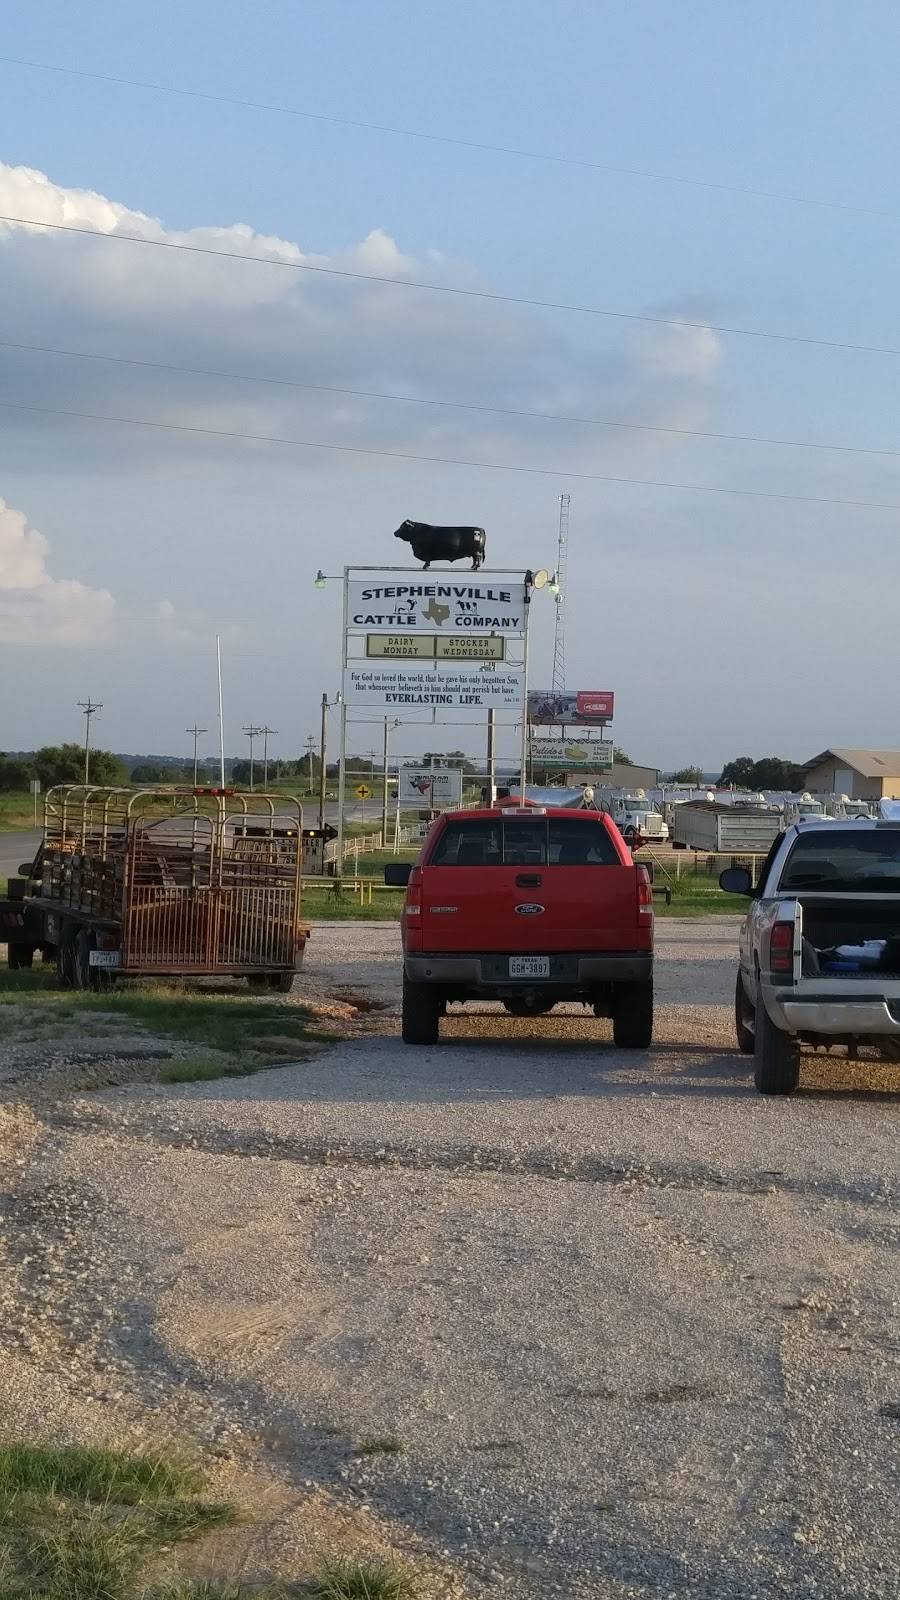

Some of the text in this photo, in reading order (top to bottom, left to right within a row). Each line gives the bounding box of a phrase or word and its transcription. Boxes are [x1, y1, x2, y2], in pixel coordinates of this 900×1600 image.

[361, 586, 511, 603] STEPHENVILLE
[353, 614, 519, 627] CATTLE COMPANY
[449, 639, 489, 648] STOCKER
[383, 647, 419, 655] MONDAY
[443, 648, 496, 656] WEDNESDAY
[351, 672, 360, 681] For
[361, 672, 373, 681] God
[381, 673, 396, 682] loved
[397, 673, 406, 682] the
[425, 673, 437, 683] that
[437, 673, 445, 683] he
[446, 676, 458, 684] gave
[459, 674, 468, 684] his
[469, 675, 480, 685] only
[481, 675, 506, 685] begotten
[355, 681, 514, 694] that whosoever believeth in him should not perish but have
[385, 693, 483, 705] EVERLASTING LIFE.
